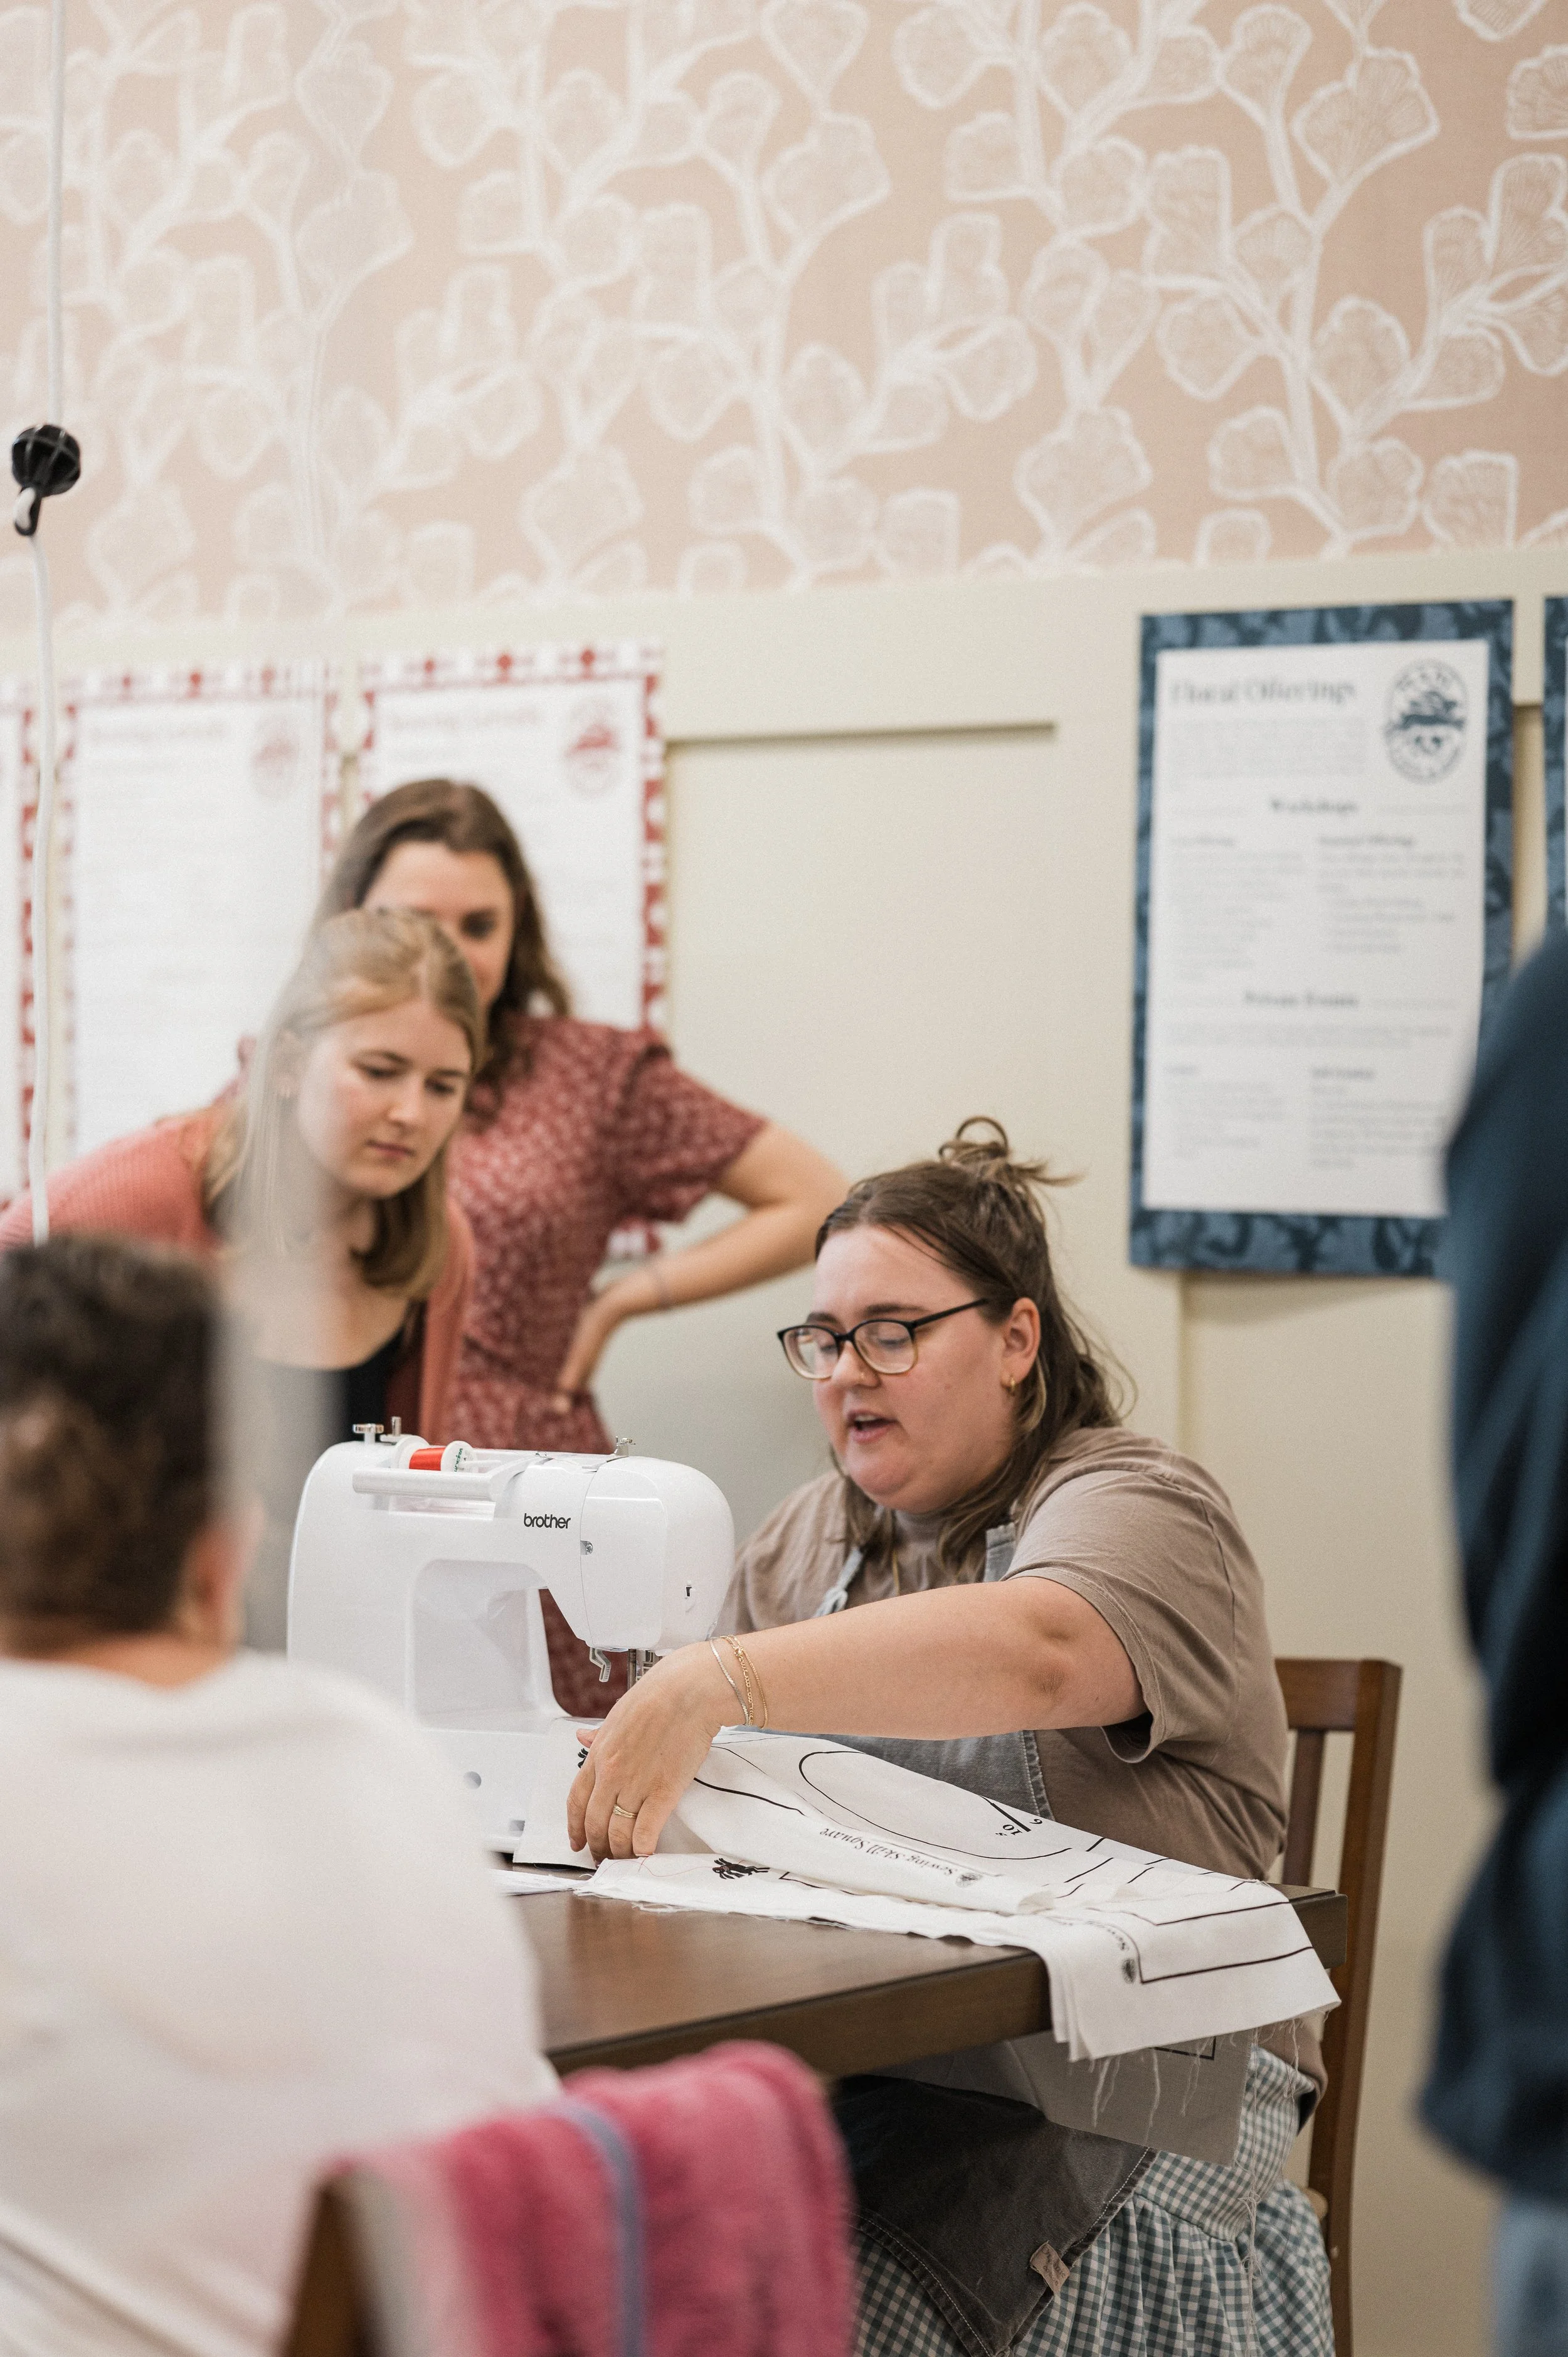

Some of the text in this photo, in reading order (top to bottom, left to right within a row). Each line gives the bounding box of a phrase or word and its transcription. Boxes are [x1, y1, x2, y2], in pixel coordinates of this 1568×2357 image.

[524, 1513, 571, 1529] brother
[1002, 1824, 1023, 1836] 10
[819, 1828, 958, 1875] Sewing Skill Square
